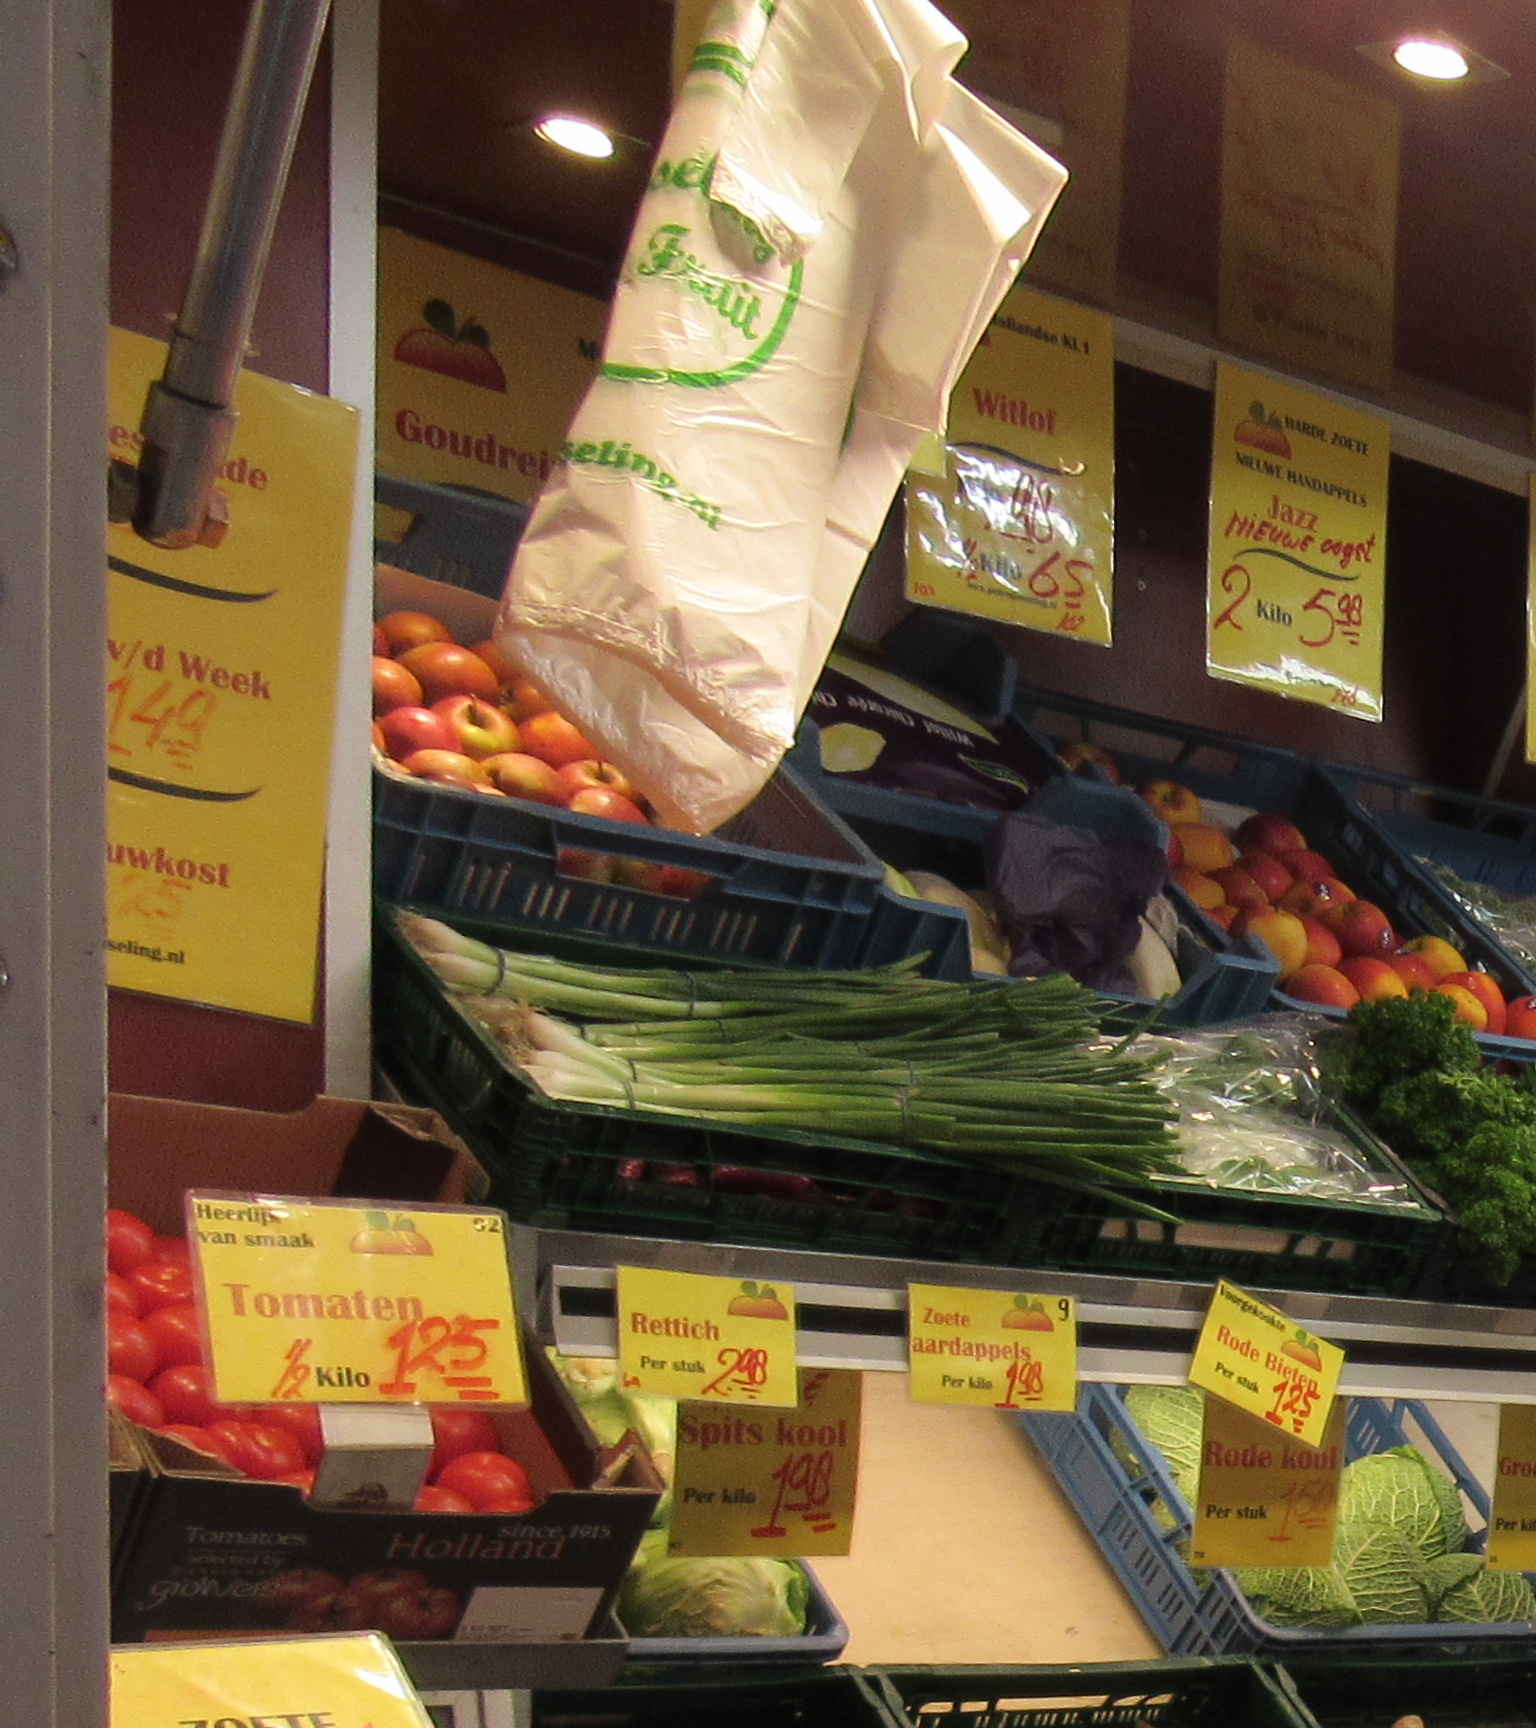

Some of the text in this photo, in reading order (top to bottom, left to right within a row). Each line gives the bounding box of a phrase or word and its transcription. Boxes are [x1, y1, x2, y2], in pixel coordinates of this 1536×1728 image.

[972, 387, 1057, 436] Witlof
[1284, 414, 1370, 458] HARDE ZOETE
[1235, 450, 1368, 508] NIEUWE HANDAPPELS
[1267, 494, 1319, 533] Jazz
[1213, 564, 1293, 630] 2 Kilo
[106, 639, 272, 701] v/d Week
[199, 1231, 315, 1249] van smaak
[222, 1284, 425, 1322] Tomaten
[1058, 1298, 1069, 1322] 9
[1219, 1285, 1287, 1335] Voorgekookte
[630, 1312, 720, 1342] Rettich
[923, 1307, 970, 1328] Zoete
[912, 1335, 1031, 1362] aardappels
[1217, 1324, 1319, 1394] Rode Bieten
[316, 1367, 371, 1389] Kilo
[640, 1355, 668, 1371] Per
[673, 1356, 706, 1374] stuk
[1213, 1361, 1260, 1394] Per stuk
[941, 1374, 964, 1389] Per
[966, 1374, 993, 1390] kilo
[681, 1415, 848, 1449] Spits kool
[1205, 1440, 1339, 1470] Rode kool
[683, 1487, 717, 1504] Per
[722, 1485, 757, 1505] kilo
[1206, 1502, 1267, 1520] Per stuk
[1496, 1517, 1516, 1533] Per
[185, 1526, 308, 1546] Tomatoes
[499, 1524, 561, 1540] since
[387, 1533, 567, 1560] Holland
